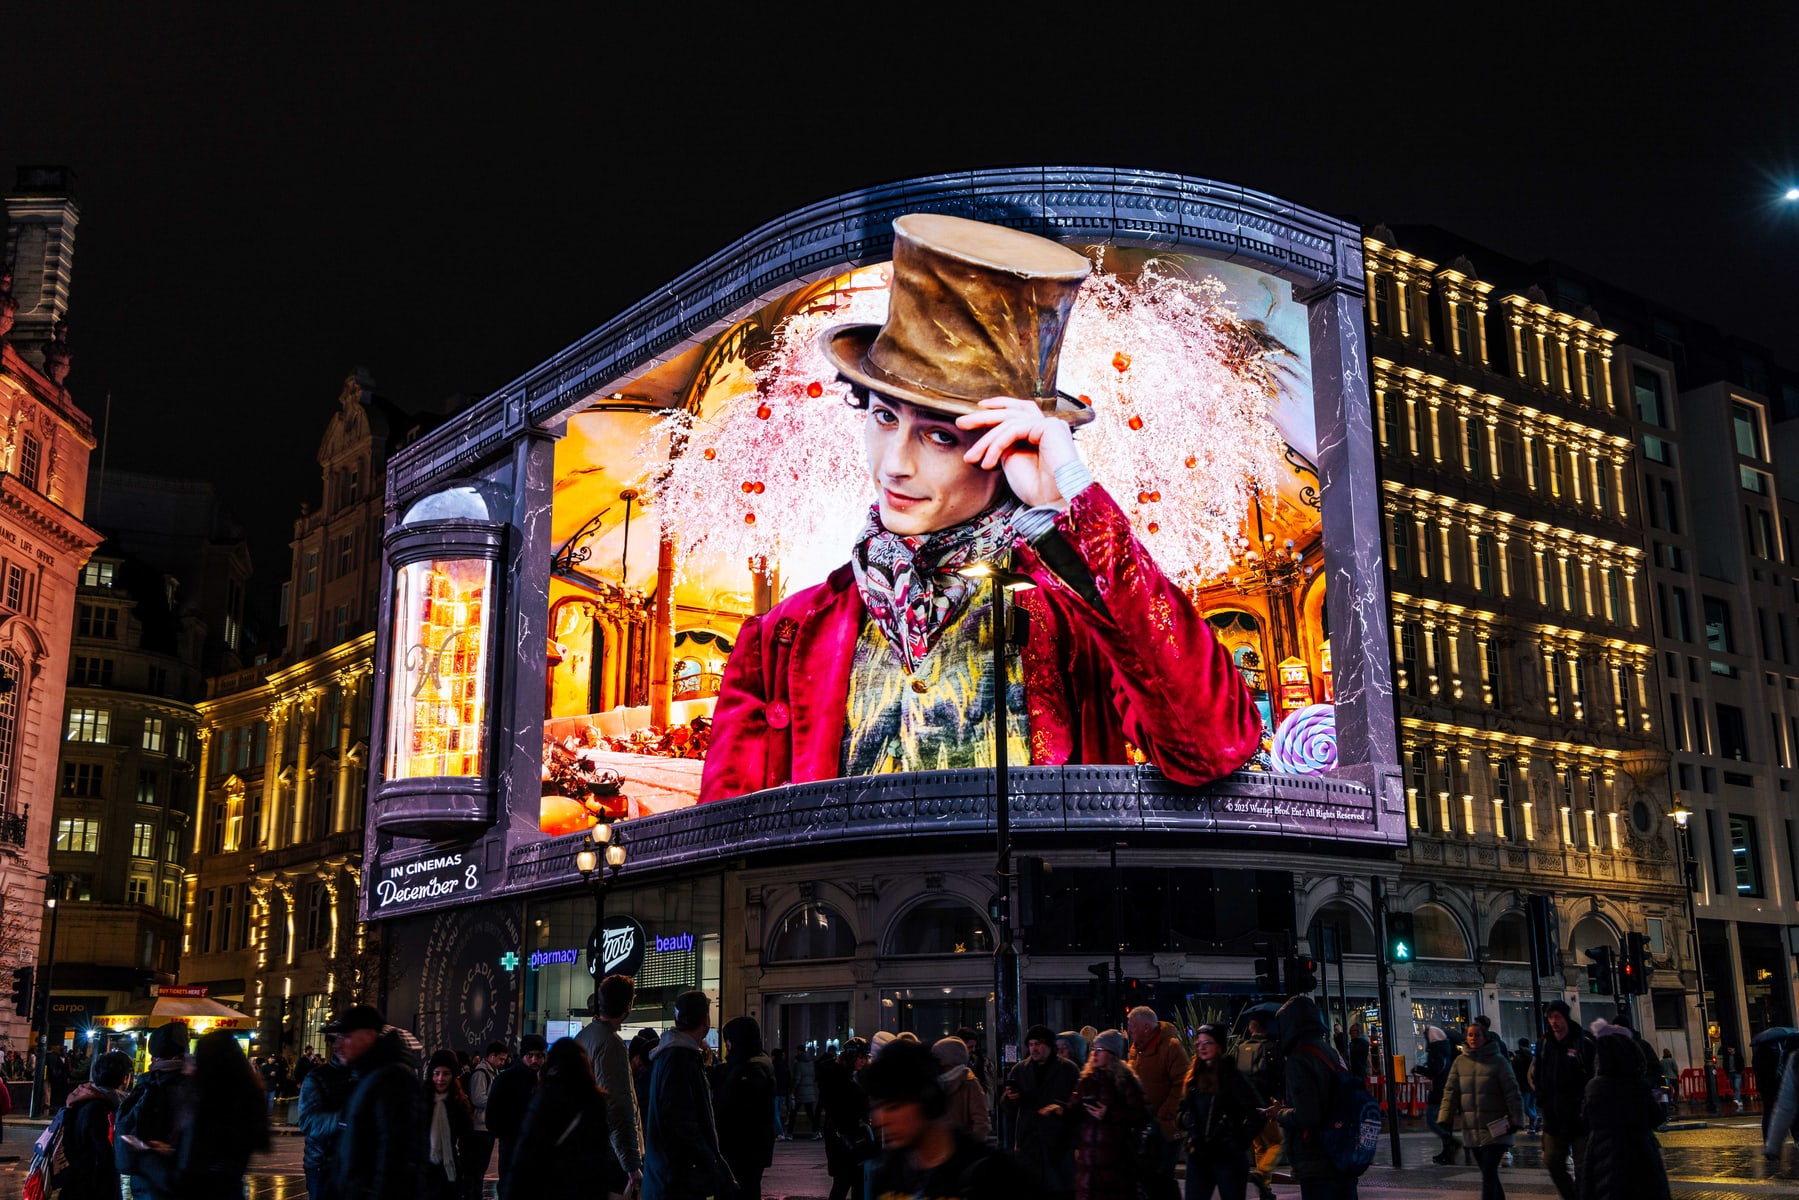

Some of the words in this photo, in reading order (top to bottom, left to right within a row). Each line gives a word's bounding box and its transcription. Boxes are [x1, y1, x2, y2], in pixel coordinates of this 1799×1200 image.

[20, 538, 33, 554] LIFE
[36, 548, 55, 567] OFFICE
[1250, 803, 1273, 814] Warner
[1305, 808, 1315, 817] All
[1316, 809, 1335, 819] Rights
[1336, 810, 1365, 820] Reserved
[390, 866, 404, 879] IN
[405, 854, 462, 875] CINEMAS
[377, 876, 460, 907] December
[464, 864, 479, 890] 8
[445, 925, 459, 953] YOU
[655, 931, 694, 953] beauty
[530, 947, 579, 969] pharmacy
[459, 961, 498, 1015] PICCADILLY
[51, 1003, 85, 1015] carpo
[214, 1018, 238, 1028] SPOT
[461, 1017, 495, 1046] LIGHTS
